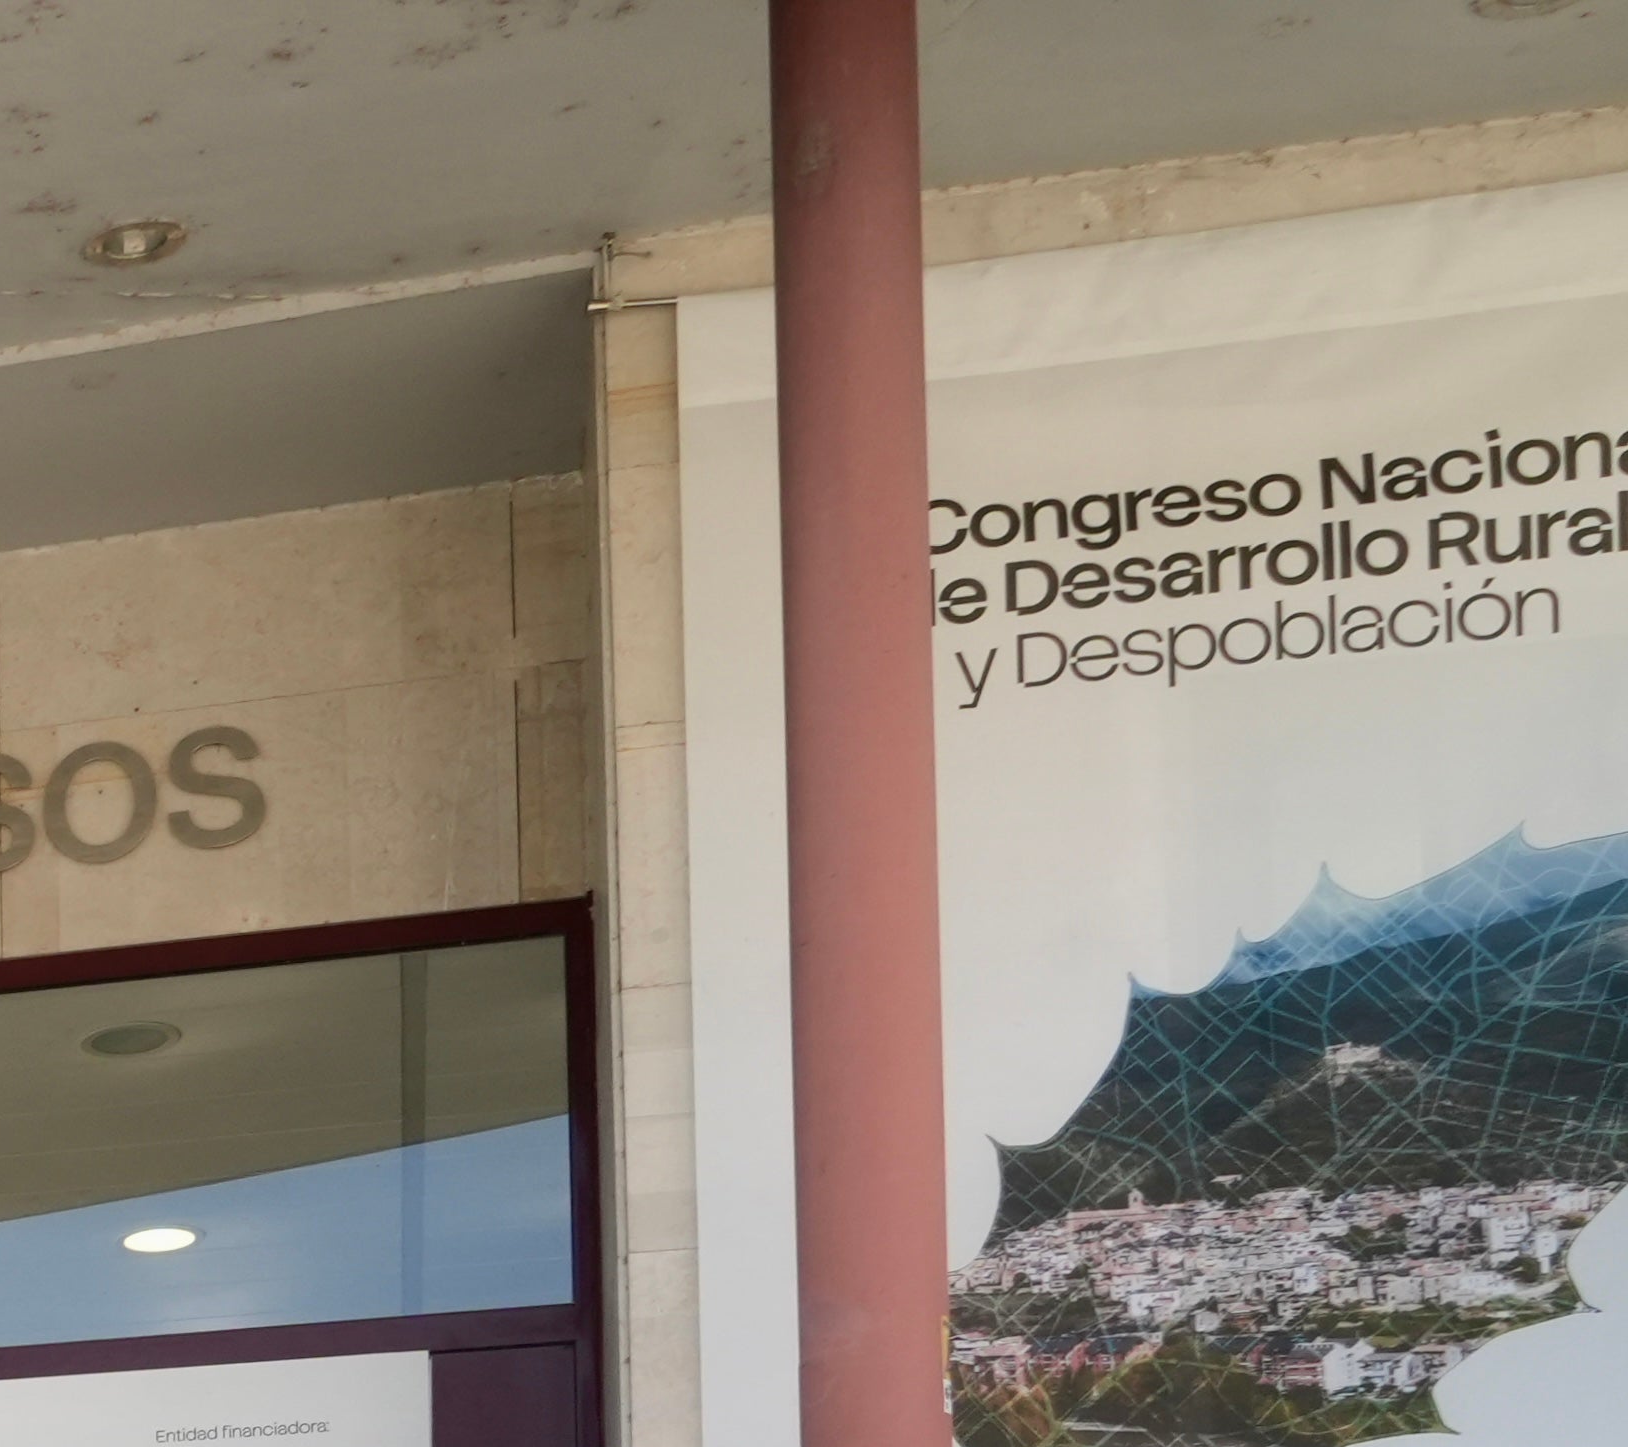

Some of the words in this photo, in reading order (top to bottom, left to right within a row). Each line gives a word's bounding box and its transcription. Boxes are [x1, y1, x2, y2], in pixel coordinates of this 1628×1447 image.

[1319, 428, 1628, 510] Nacion
[930, 568, 988, 626] e
[1005, 521, 1410, 617] Desarrollo
[955, 647, 998, 709] y
[1016, 578, 1561, 688] Despoblación
[156, 1427, 218, 1443] Entidad
[222, 1421, 330, 1439] financiadora:
